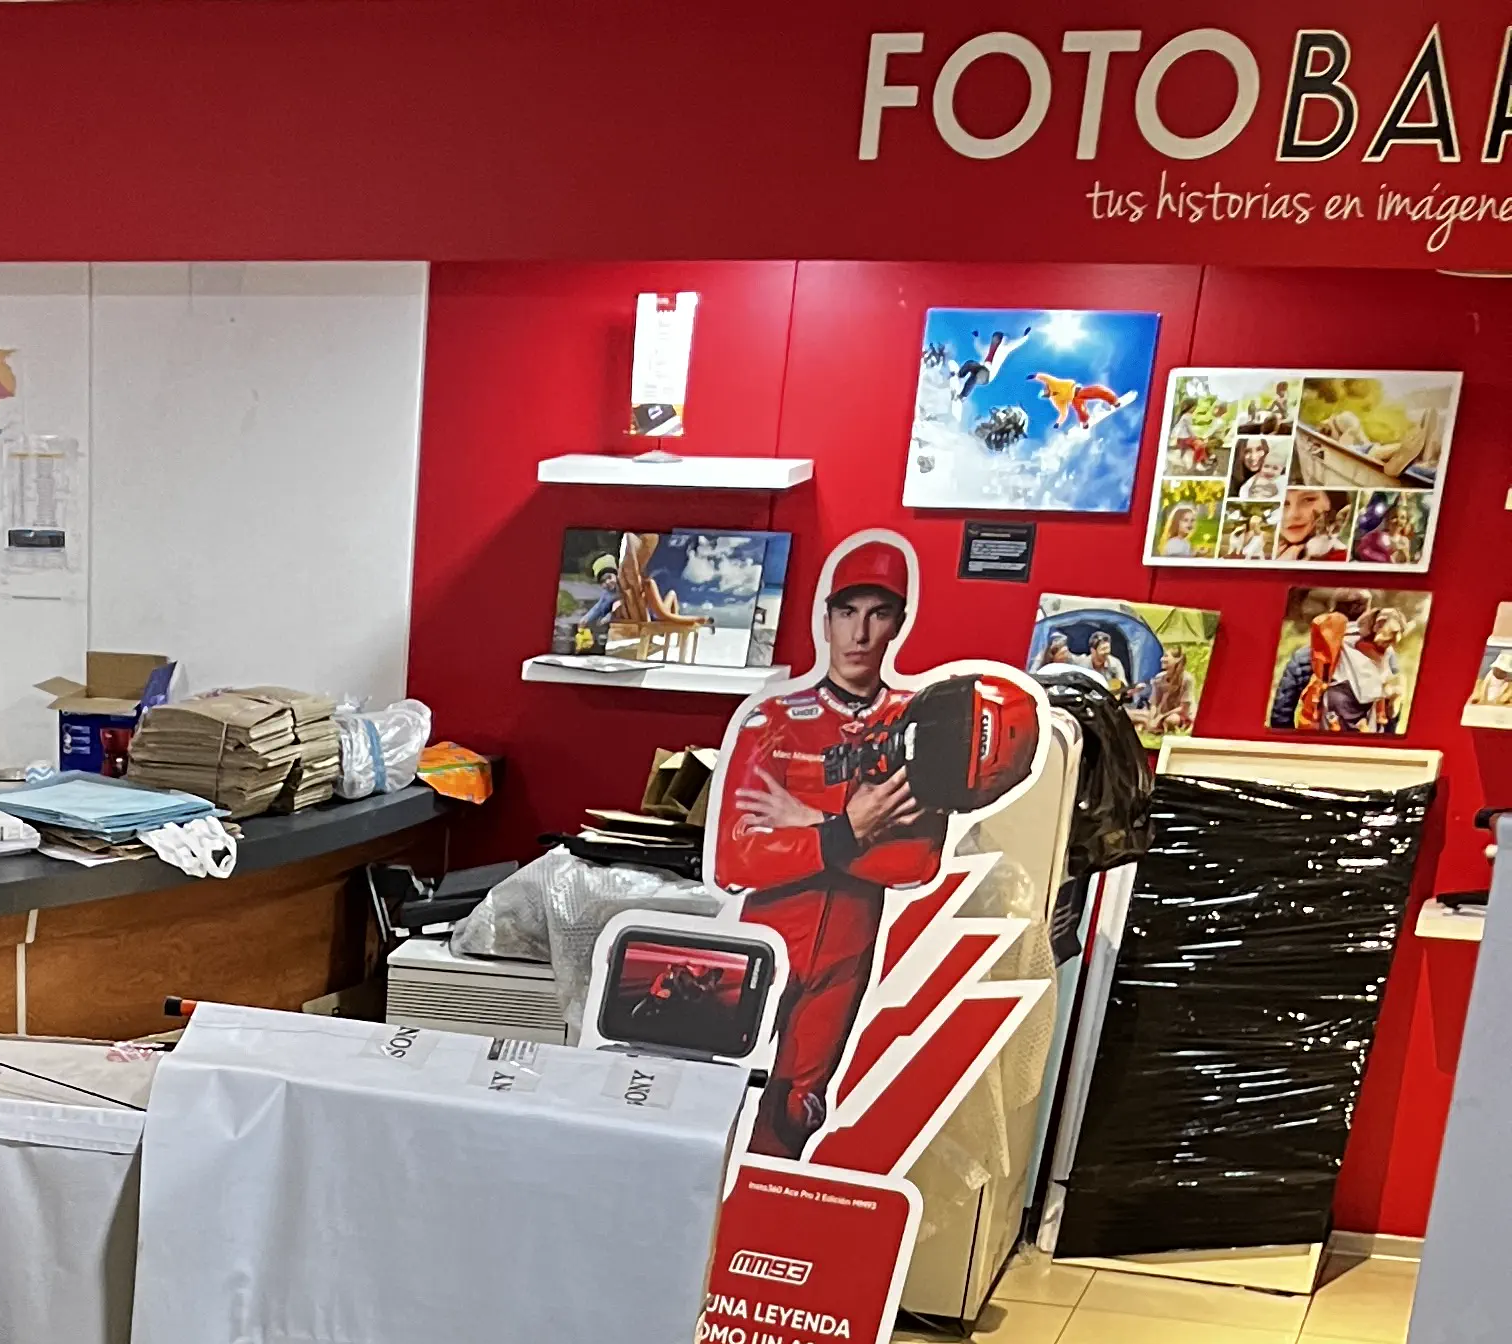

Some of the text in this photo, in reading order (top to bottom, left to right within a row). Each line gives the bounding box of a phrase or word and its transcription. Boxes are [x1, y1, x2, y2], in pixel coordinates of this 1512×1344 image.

[1086, 182, 1147, 224] tus
[1156, 171, 1316, 225] historias
[1324, 193, 1365, 221] en
[624, 1069, 655, 1106] ONY
[706, 1294, 850, 1339] UNA LEYENDA
